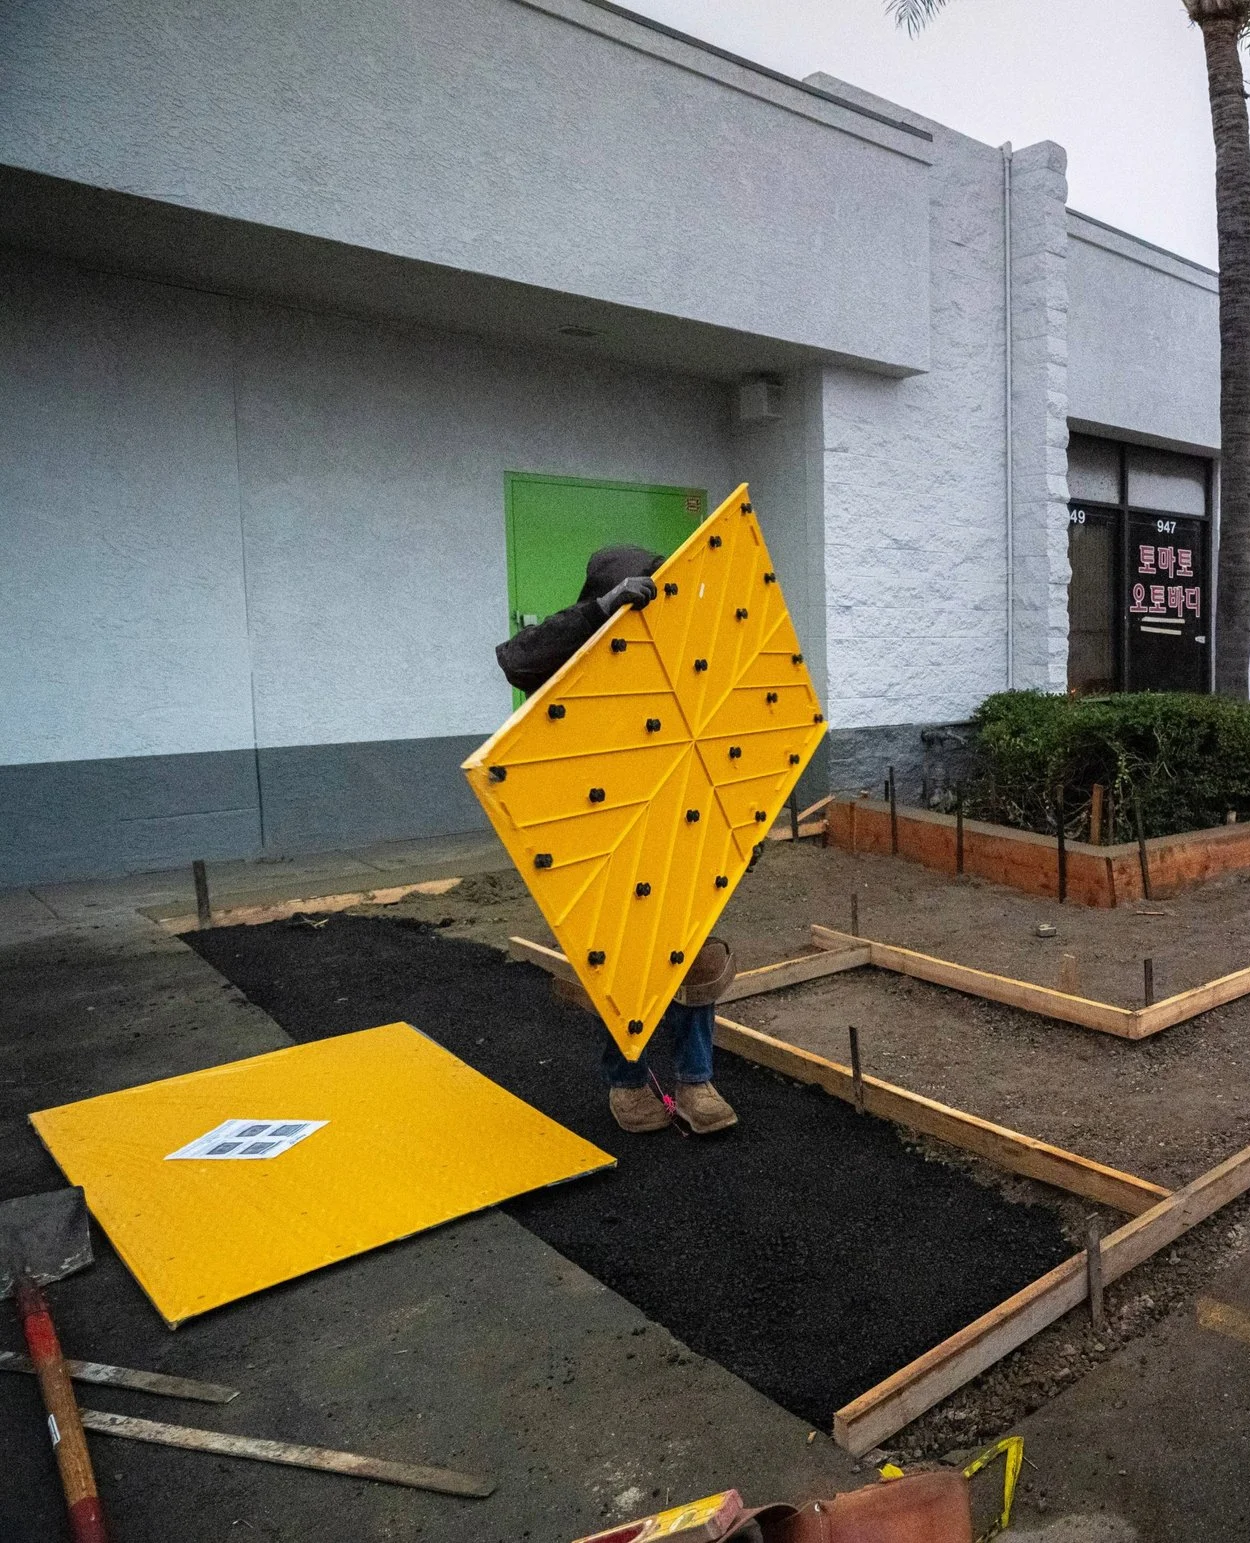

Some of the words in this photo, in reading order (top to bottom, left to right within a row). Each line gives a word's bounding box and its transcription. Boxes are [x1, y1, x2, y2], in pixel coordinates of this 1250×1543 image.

[1070, 509, 1086, 524] 49
[1157, 519, 1177, 534] 947
[1138, 545, 1194, 579] 토마토
[1129, 583, 1201, 618] 오토바디
